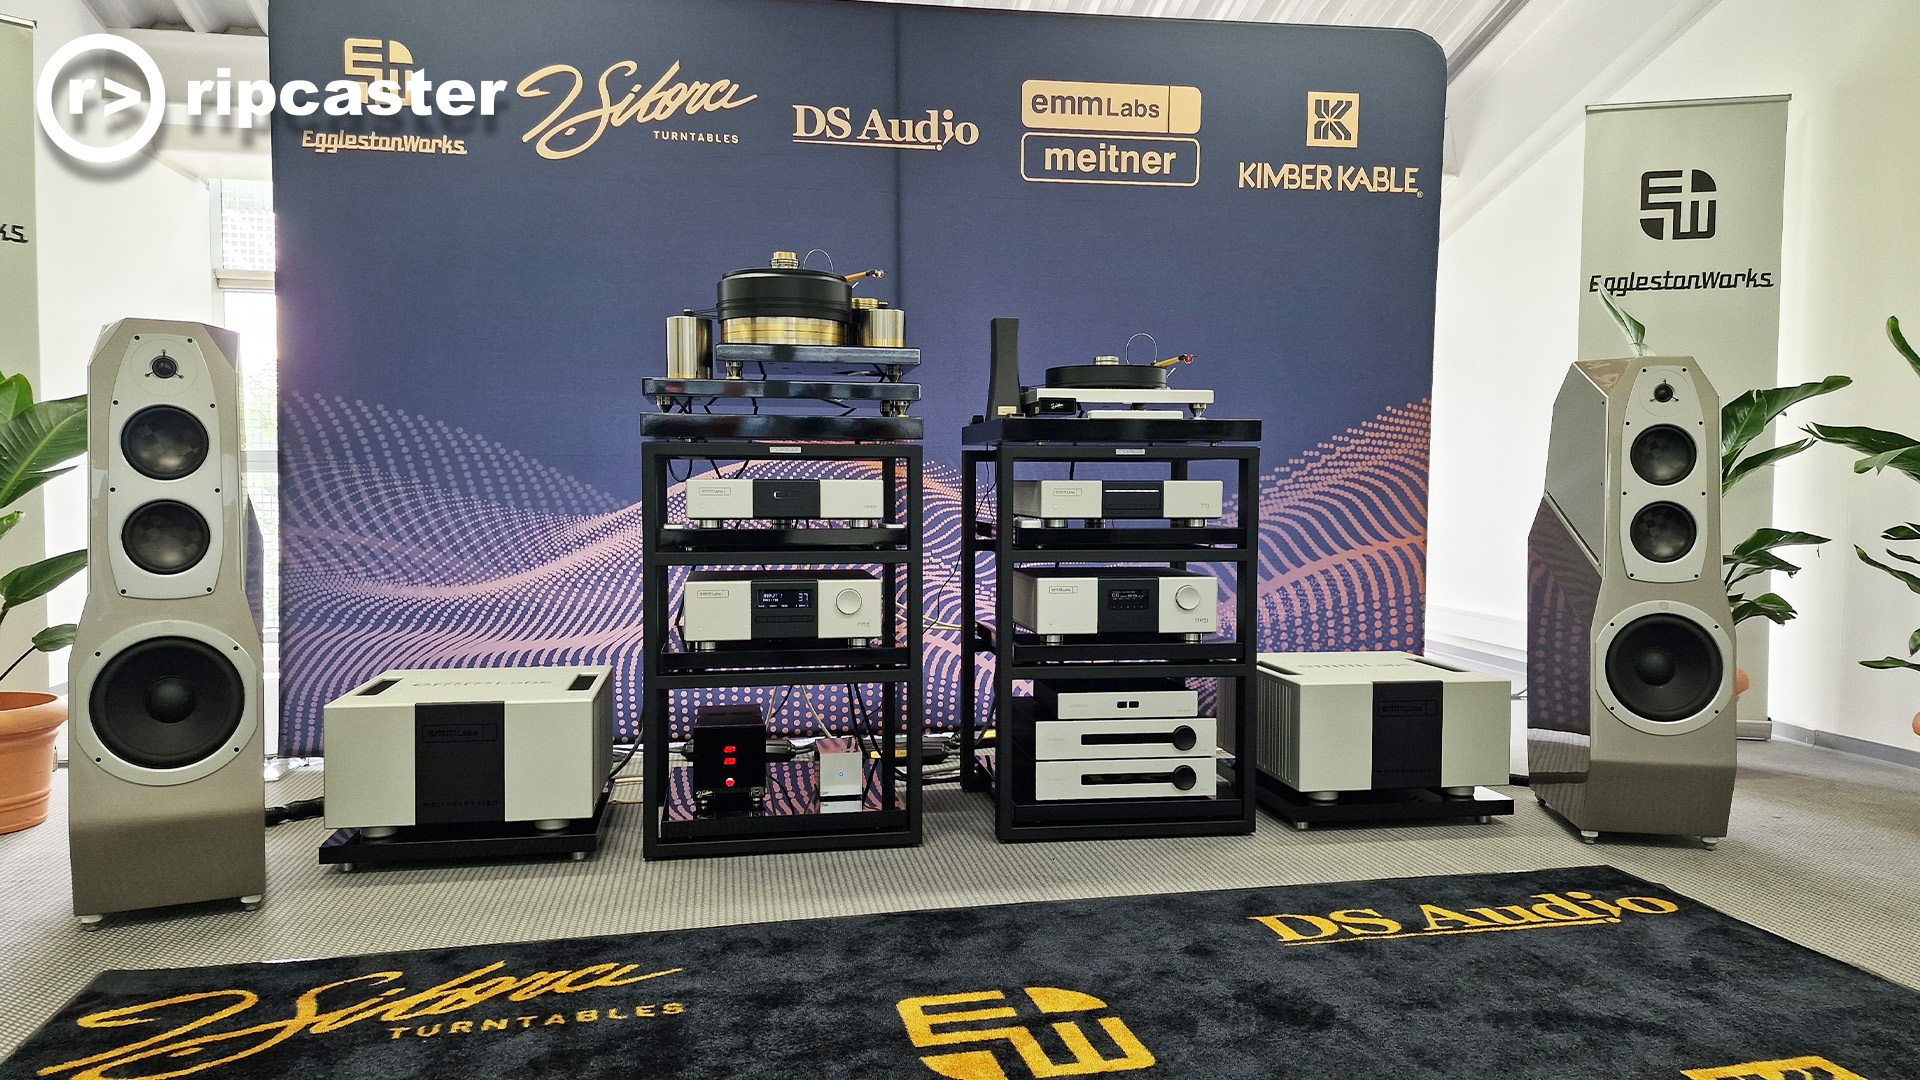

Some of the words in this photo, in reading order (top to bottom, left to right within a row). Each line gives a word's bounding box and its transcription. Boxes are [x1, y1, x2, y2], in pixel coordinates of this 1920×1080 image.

[653, 130, 739, 144] TURNTABLES
[793, 104, 852, 140] DS
[857, 108, 980, 146] Audio
[302, 130, 467, 155] EgglestonWorks
[1043, 143, 1177, 176] meitner
[1238, 161, 1333, 191] KIMBER
[1247, 908, 1402, 942] DS
[1419, 891, 1679, 931] Audio
[389, 1002, 684, 1040] TURNTABLES
